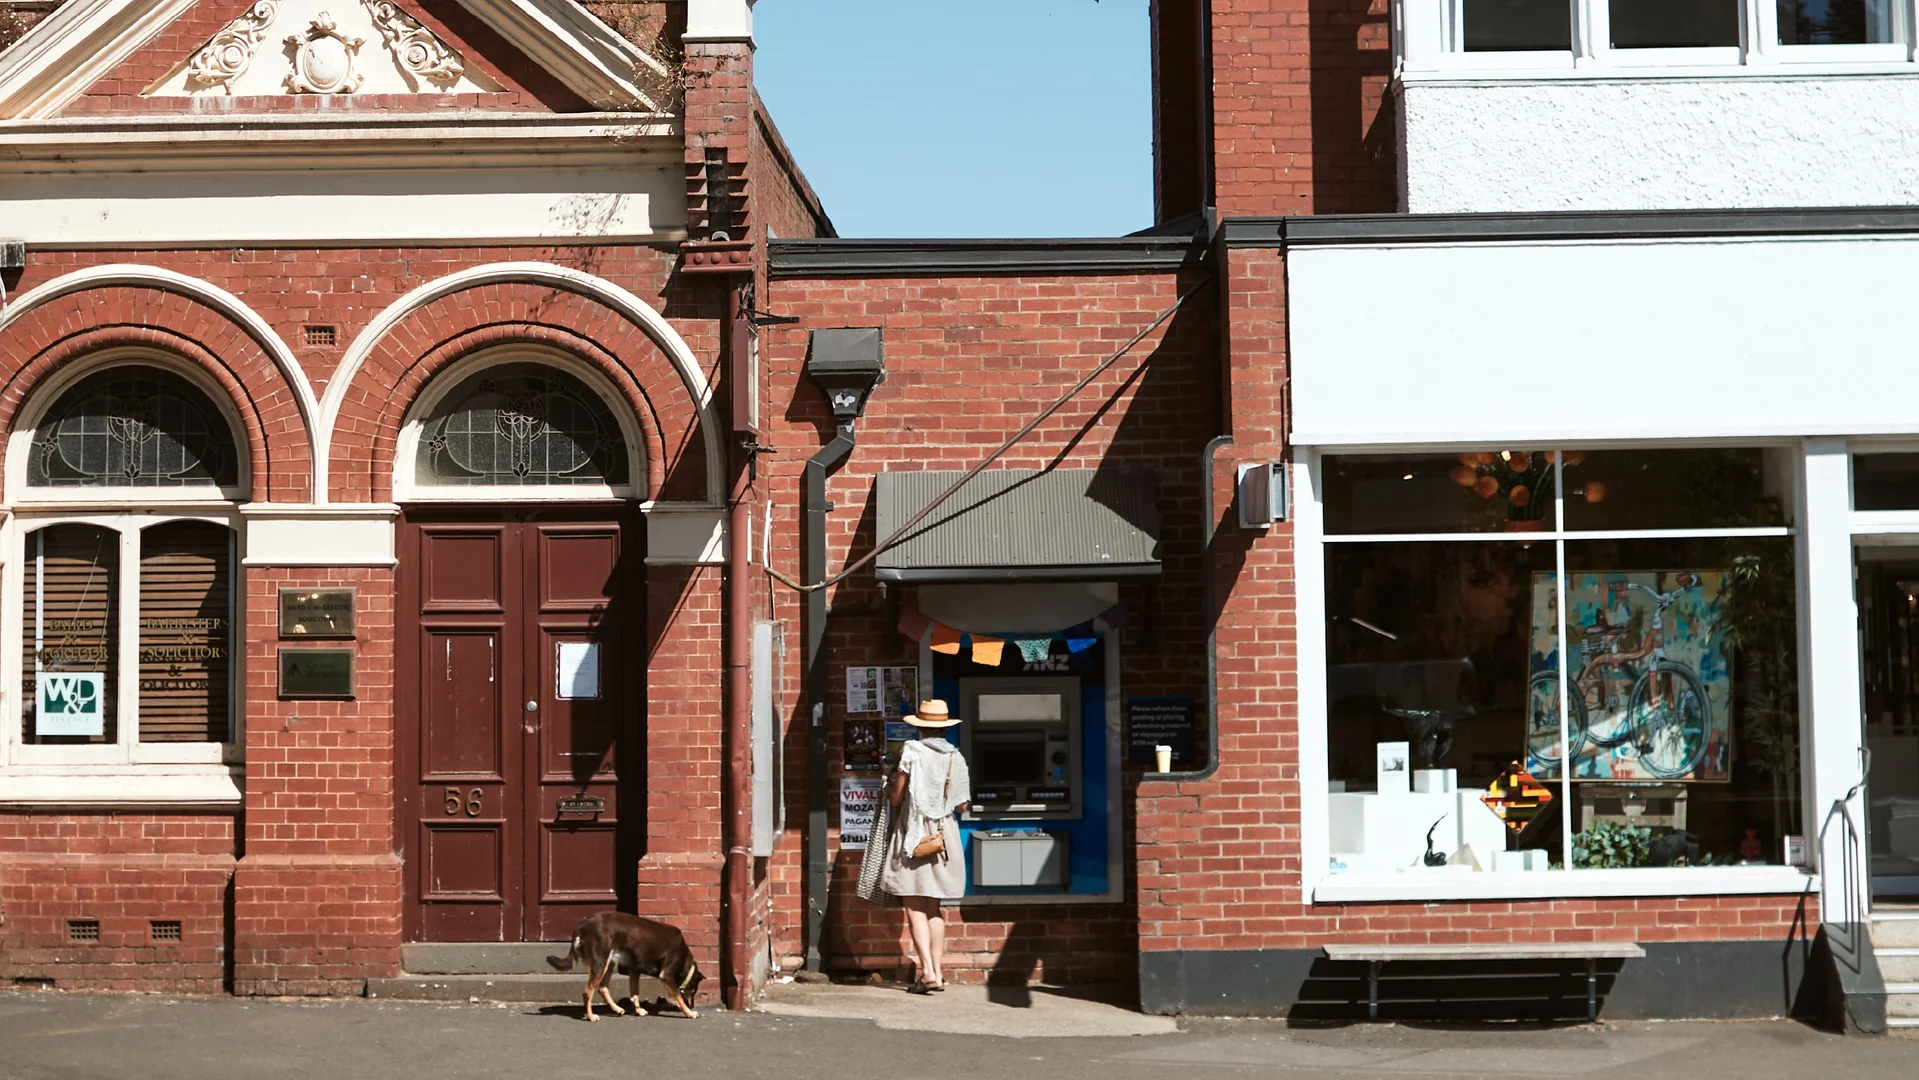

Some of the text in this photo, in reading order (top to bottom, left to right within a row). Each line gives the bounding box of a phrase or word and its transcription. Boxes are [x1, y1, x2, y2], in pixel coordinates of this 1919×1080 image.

[49, 619, 94, 631] BAIRD
[147, 618, 230, 630] BARRISTERS
[182, 633, 194, 645] &
[147, 647, 228, 659] SOLICITORS
[1023, 654, 1070, 671] ANZ
[445, 786, 484, 817] 56
